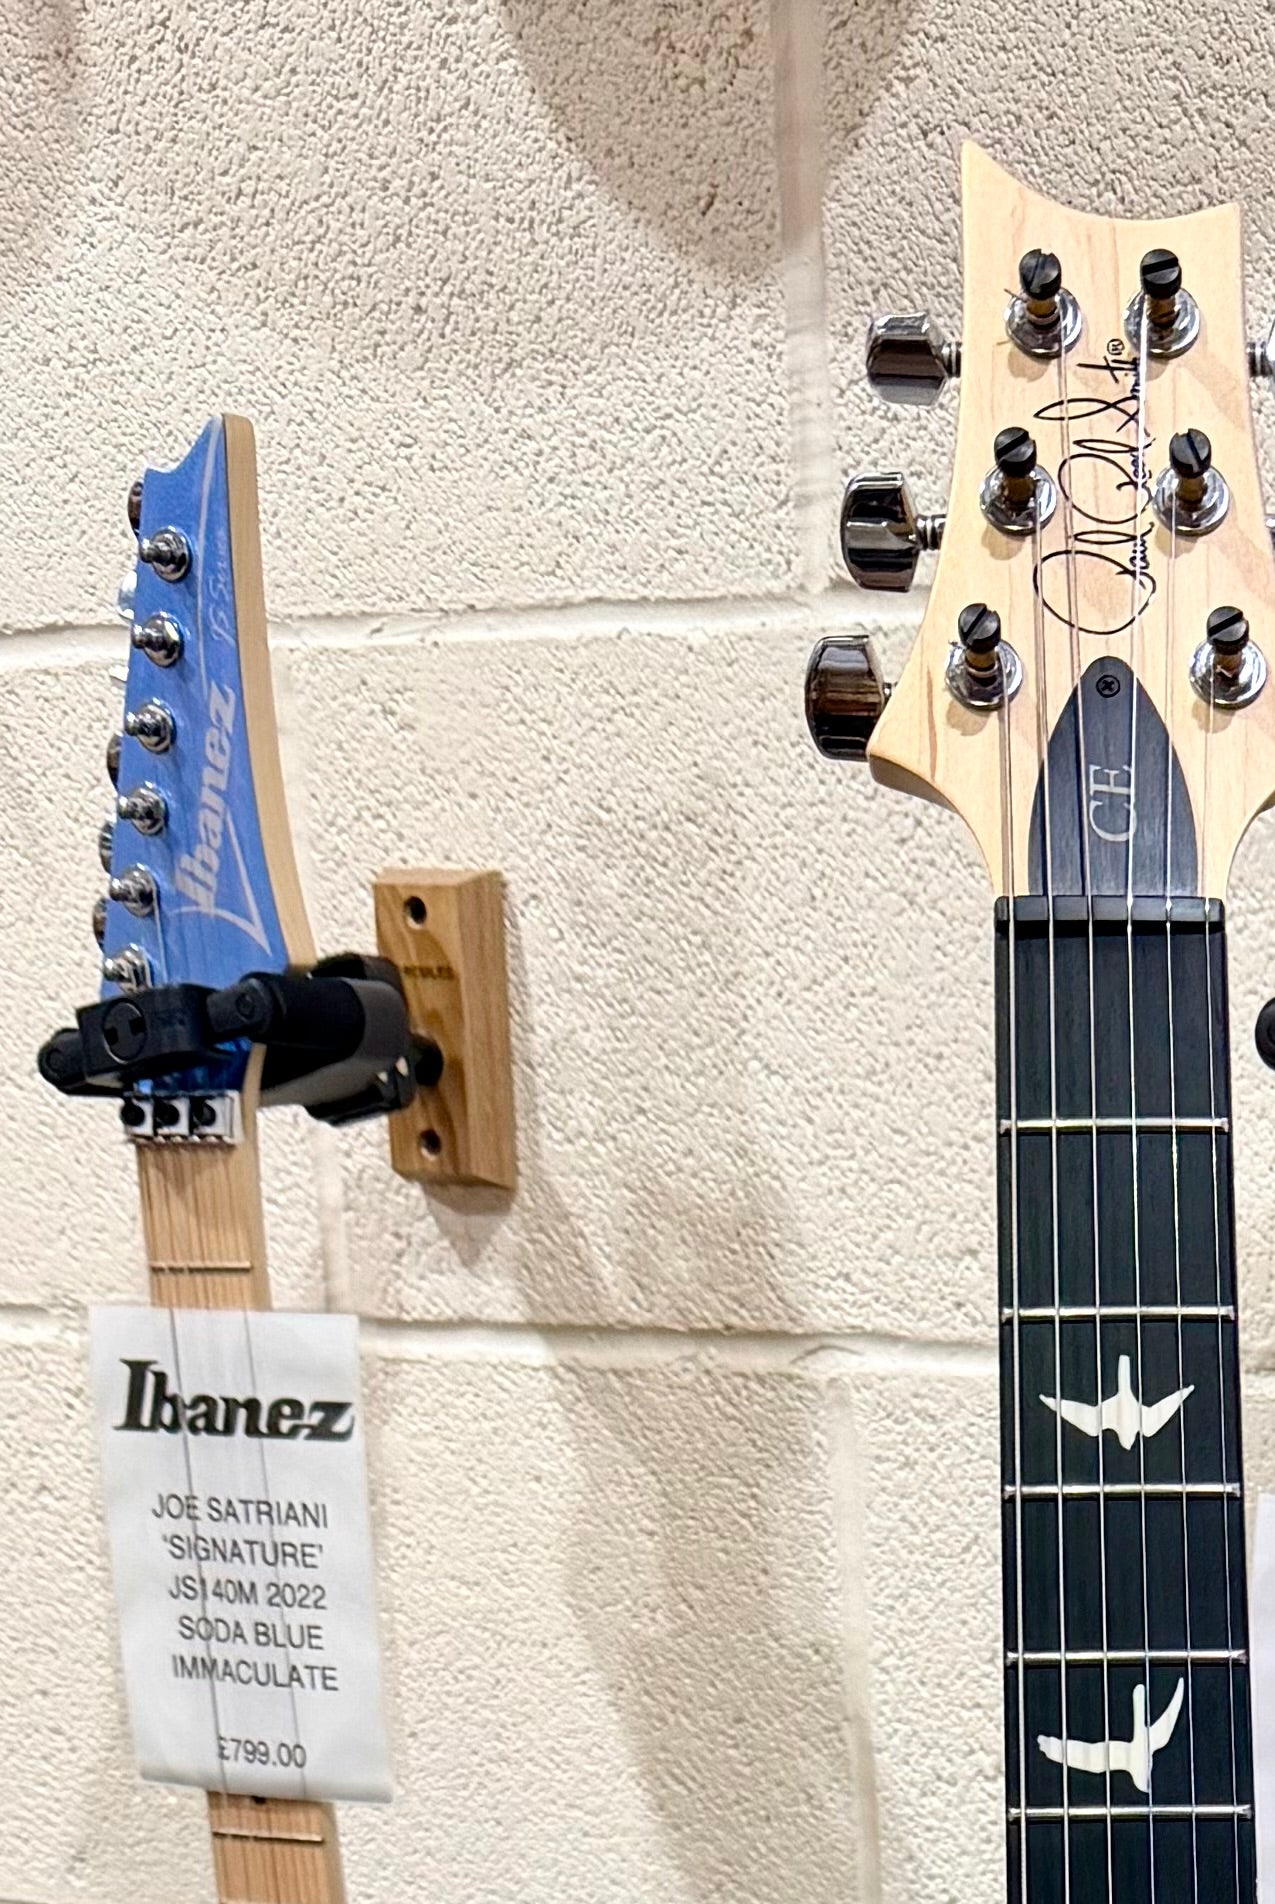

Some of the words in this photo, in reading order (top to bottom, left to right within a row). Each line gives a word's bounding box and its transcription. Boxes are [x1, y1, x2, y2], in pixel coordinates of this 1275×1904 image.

[176, 680, 236, 918] Ibanez
[1089, 764, 1138, 842] CE
[112, 1358, 356, 1442] Ibanez
[152, 1493, 202, 1521] JOE
[206, 1496, 328, 1529] SATRIANI
[266, 1582, 328, 1610] 2022
[178, 1615, 248, 1645] SODA
[255, 1621, 324, 1650] BLUE
[172, 1654, 339, 1691] IMMACULATE
[217, 1736, 307, 1769] £799.00
